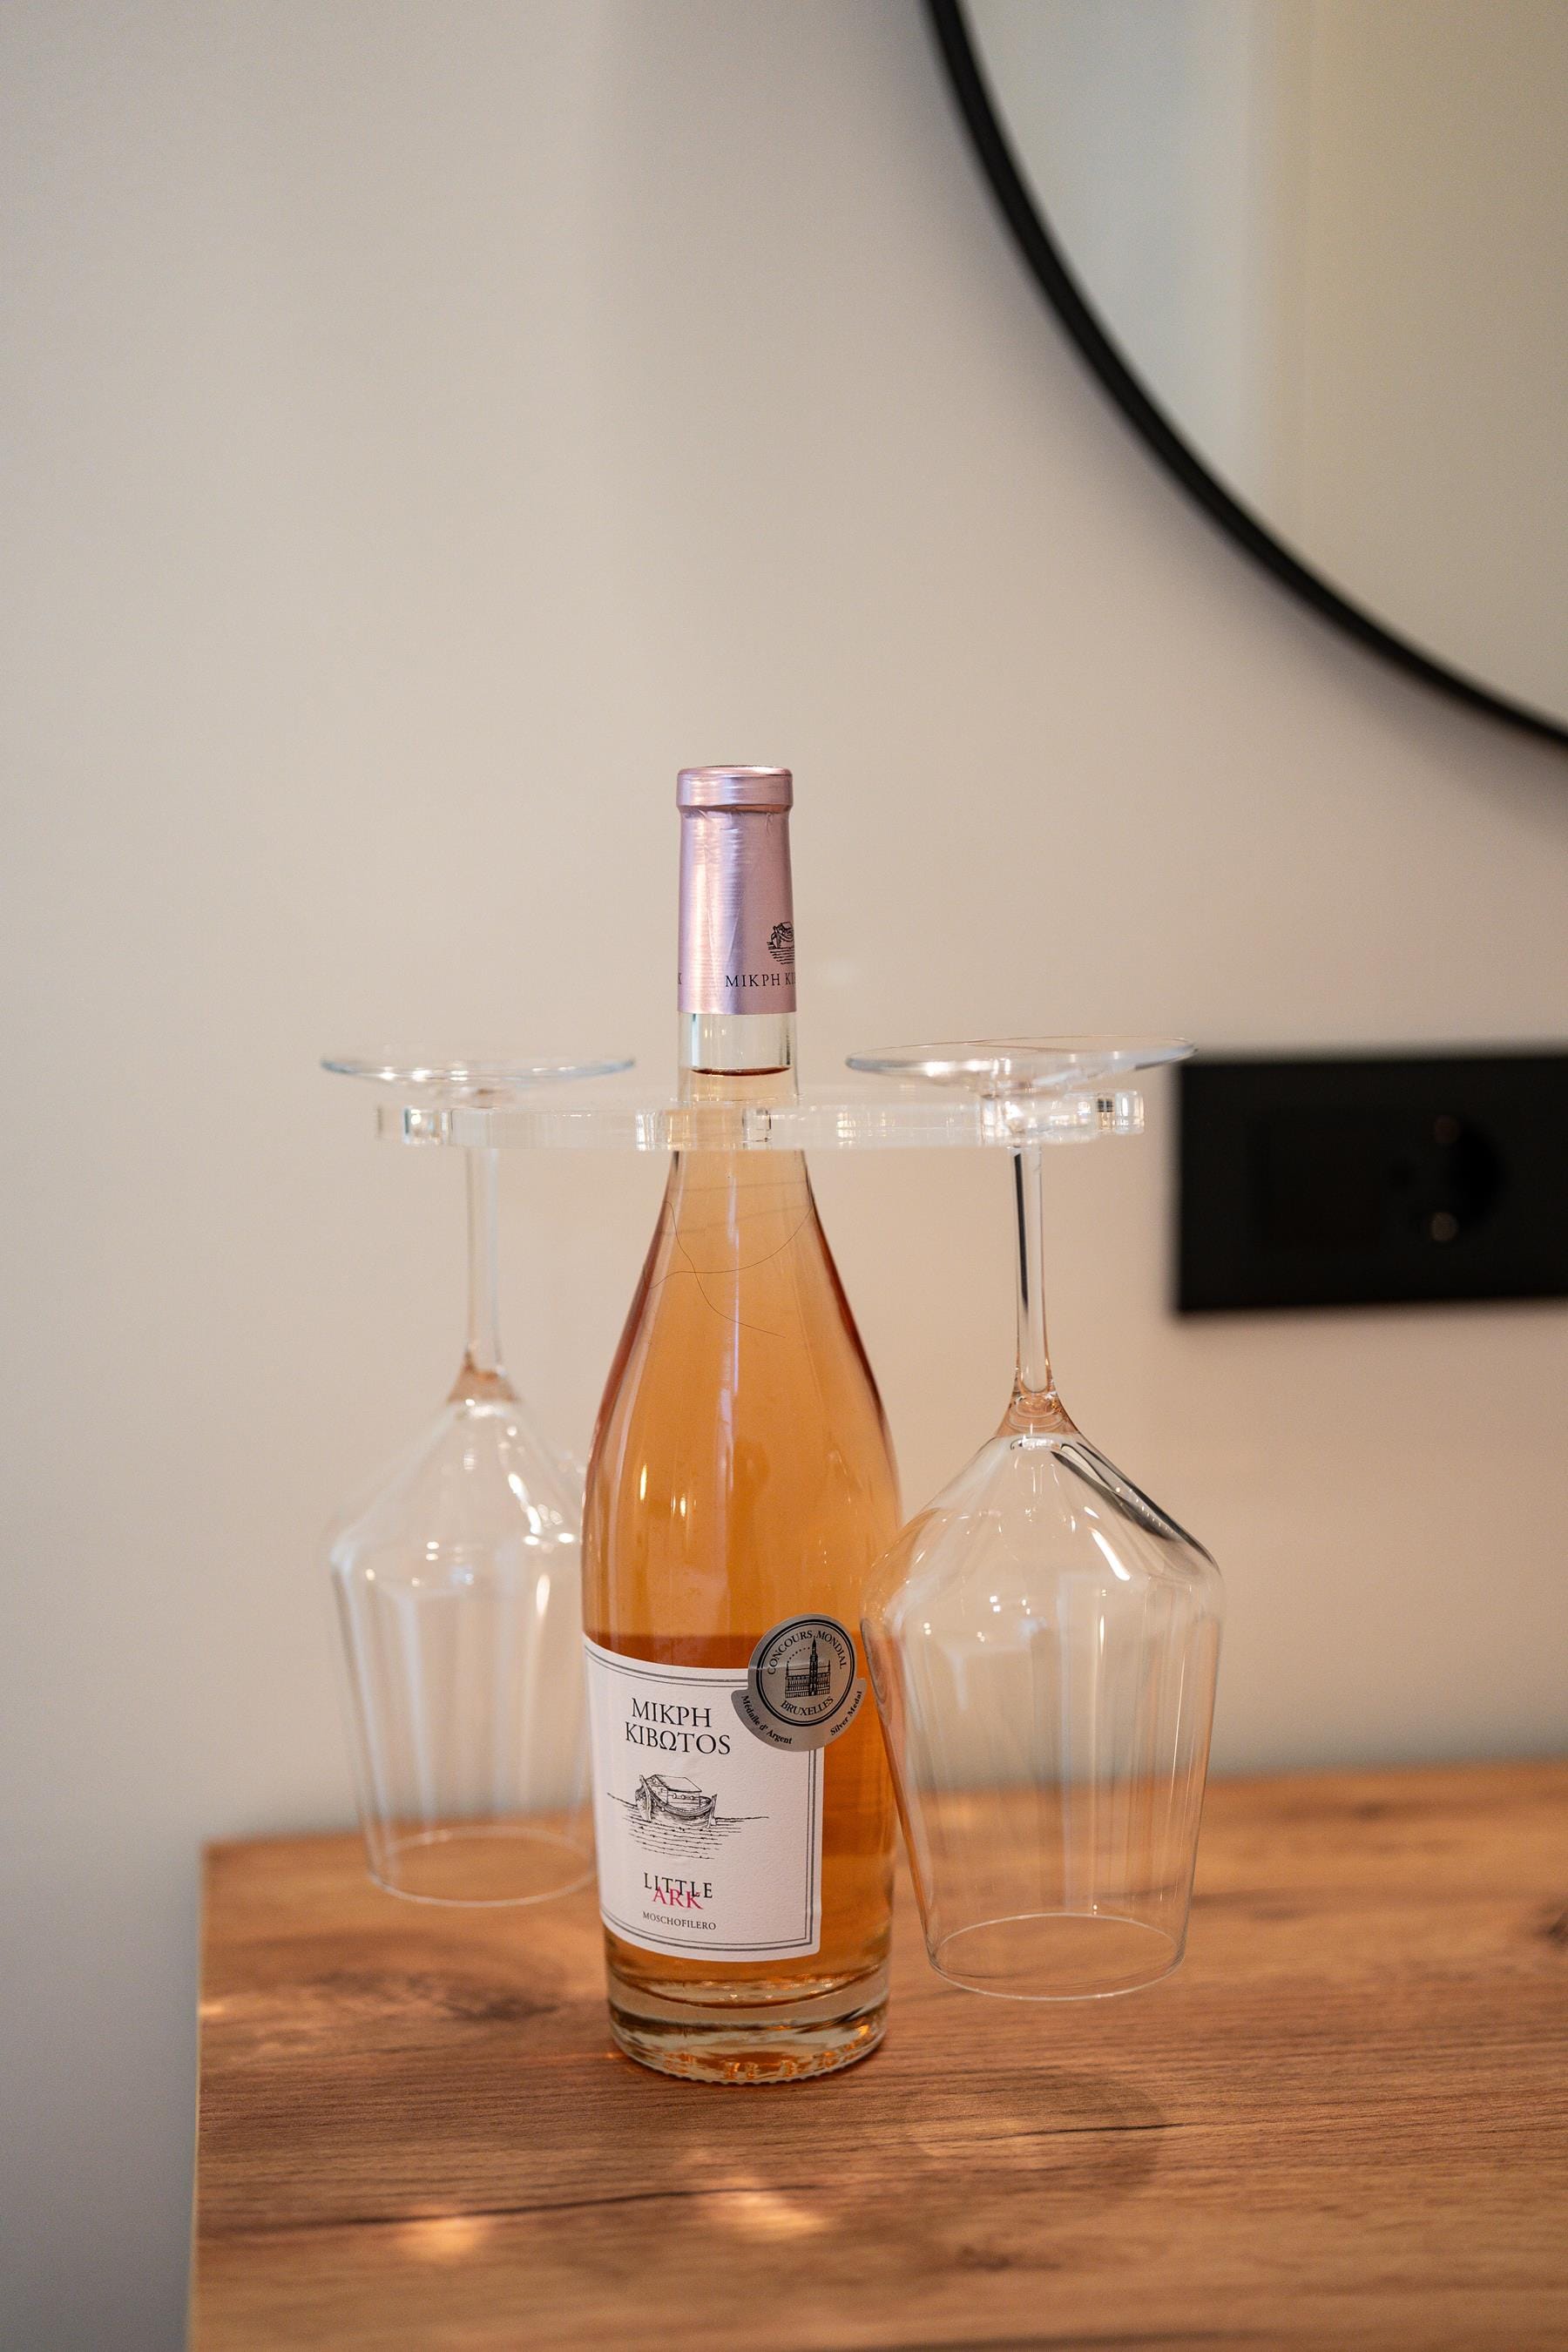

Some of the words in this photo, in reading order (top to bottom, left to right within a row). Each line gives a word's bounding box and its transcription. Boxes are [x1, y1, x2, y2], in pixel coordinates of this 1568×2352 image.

[767, 1630, 813, 1675] CONCOURS
[816, 1630, 847, 1669] MONDIAL
[632, 1698, 712, 1727] ΜΙΚΡΗ
[781, 1696, 834, 1716] BRUXELLES
[830, 1718, 849, 1736] Silver
[847, 1691, 862, 1717] Medal
[767, 1729, 793, 1745] Argent
[644, 1872, 713, 1898] LITTLE
[652, 1886, 704, 1909] ARK
[642, 1910, 717, 1930] MOSCHOFILERO
